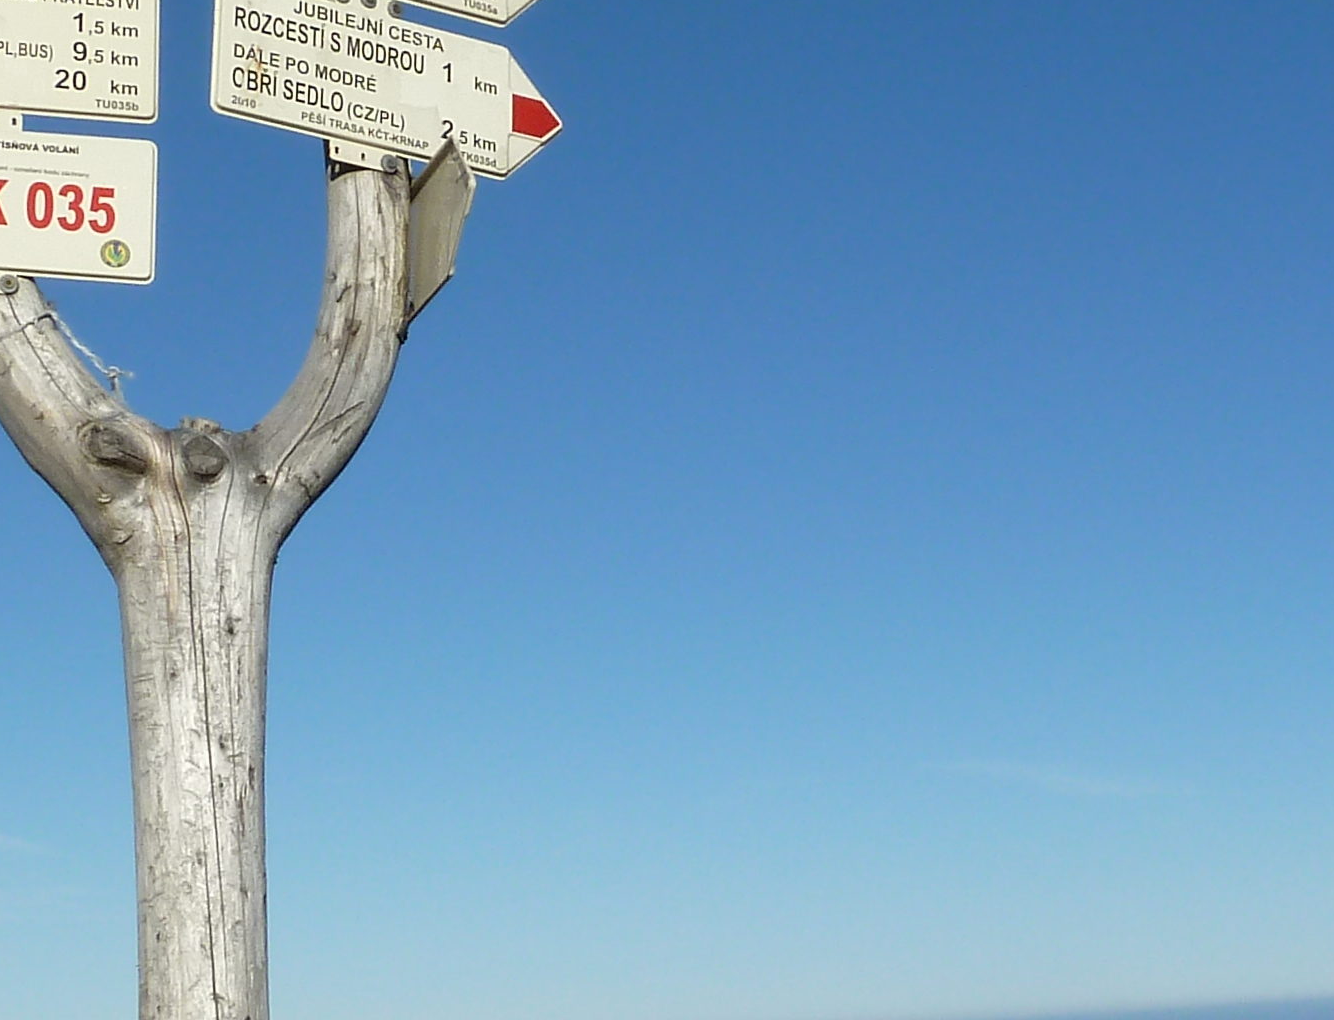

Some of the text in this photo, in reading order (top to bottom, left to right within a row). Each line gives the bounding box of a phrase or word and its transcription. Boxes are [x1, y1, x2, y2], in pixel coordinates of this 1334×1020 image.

[73, 13, 104, 36] 1,5
[112, 22, 139, 37] km
[294, 1, 444, 53] JUBILEJNÍ CESTA
[73, 42, 104, 65] 9,5
[111, 51, 138, 66] km
[234, 43, 377, 92] DÁLE PO MODRÉ
[235, 7, 497, 95] ROZCESTÍ S MODROU 1 km
[55, 69, 86, 90] 20
[111, 80, 138, 95] km
[96, 99, 139, 111] TU035b
[233, 67, 276, 96] OBŘÍ
[283, 79, 343, 112] SEDLO
[348, 102, 405, 132] (CZ/PL)
[474, 134, 496, 152] km
[302, 112, 326, 126] PĚŠÍ
[330, 118, 365, 135] TRASA
[27, 182, 116, 234] 035
